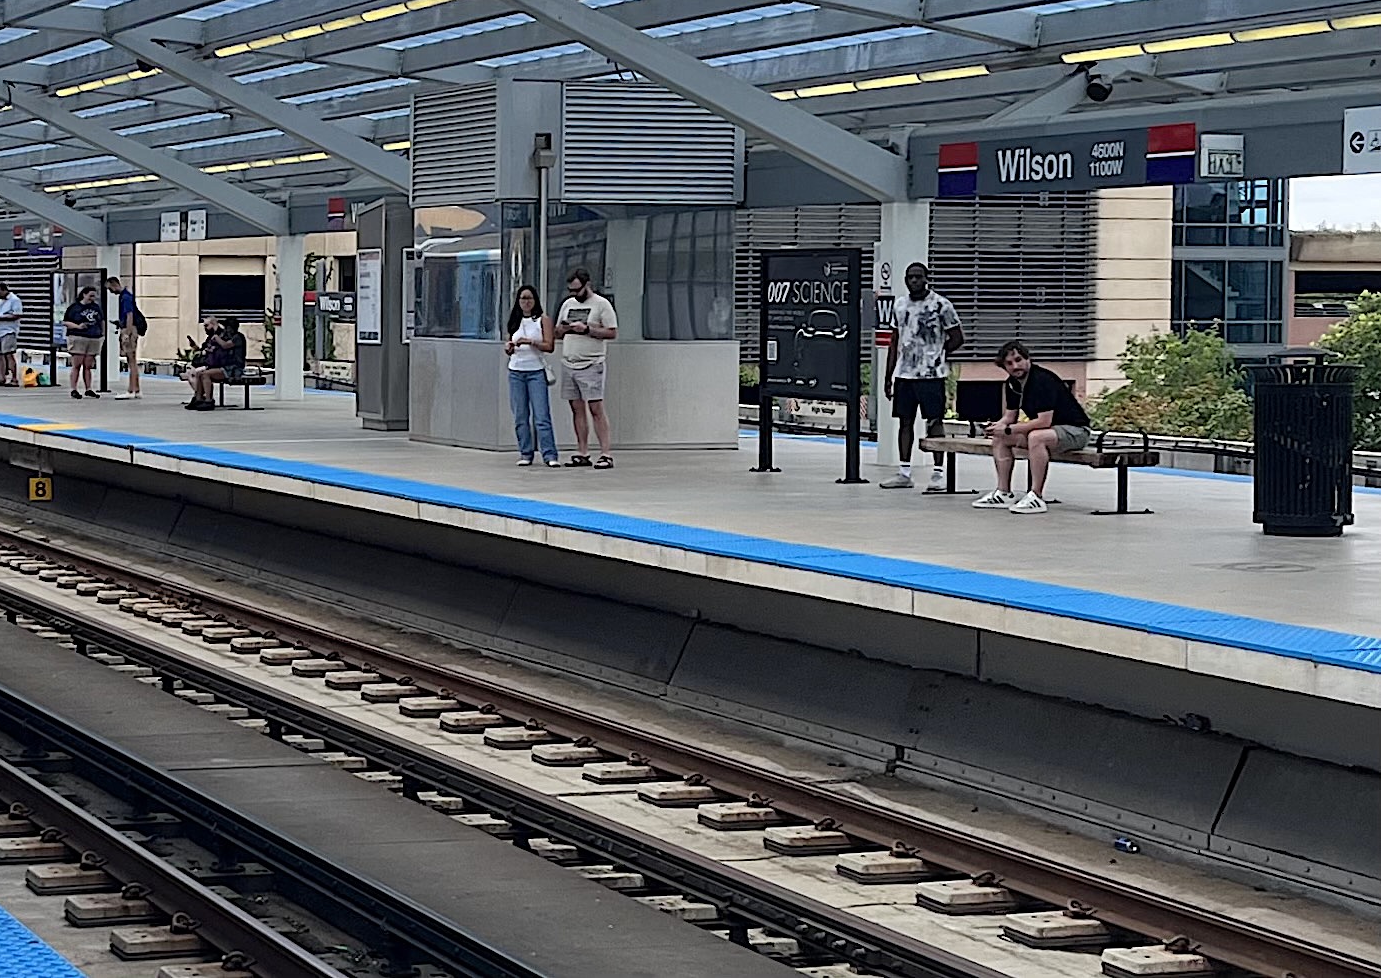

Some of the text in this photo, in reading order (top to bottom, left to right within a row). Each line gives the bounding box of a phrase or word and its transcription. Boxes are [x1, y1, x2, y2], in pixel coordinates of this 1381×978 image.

[997, 148, 1072, 182] Wilson
[1089, 159, 1124, 176] 1100W
[767, 281, 849, 304] 007 SCIENCE
[34, 481, 47, 497] 8
